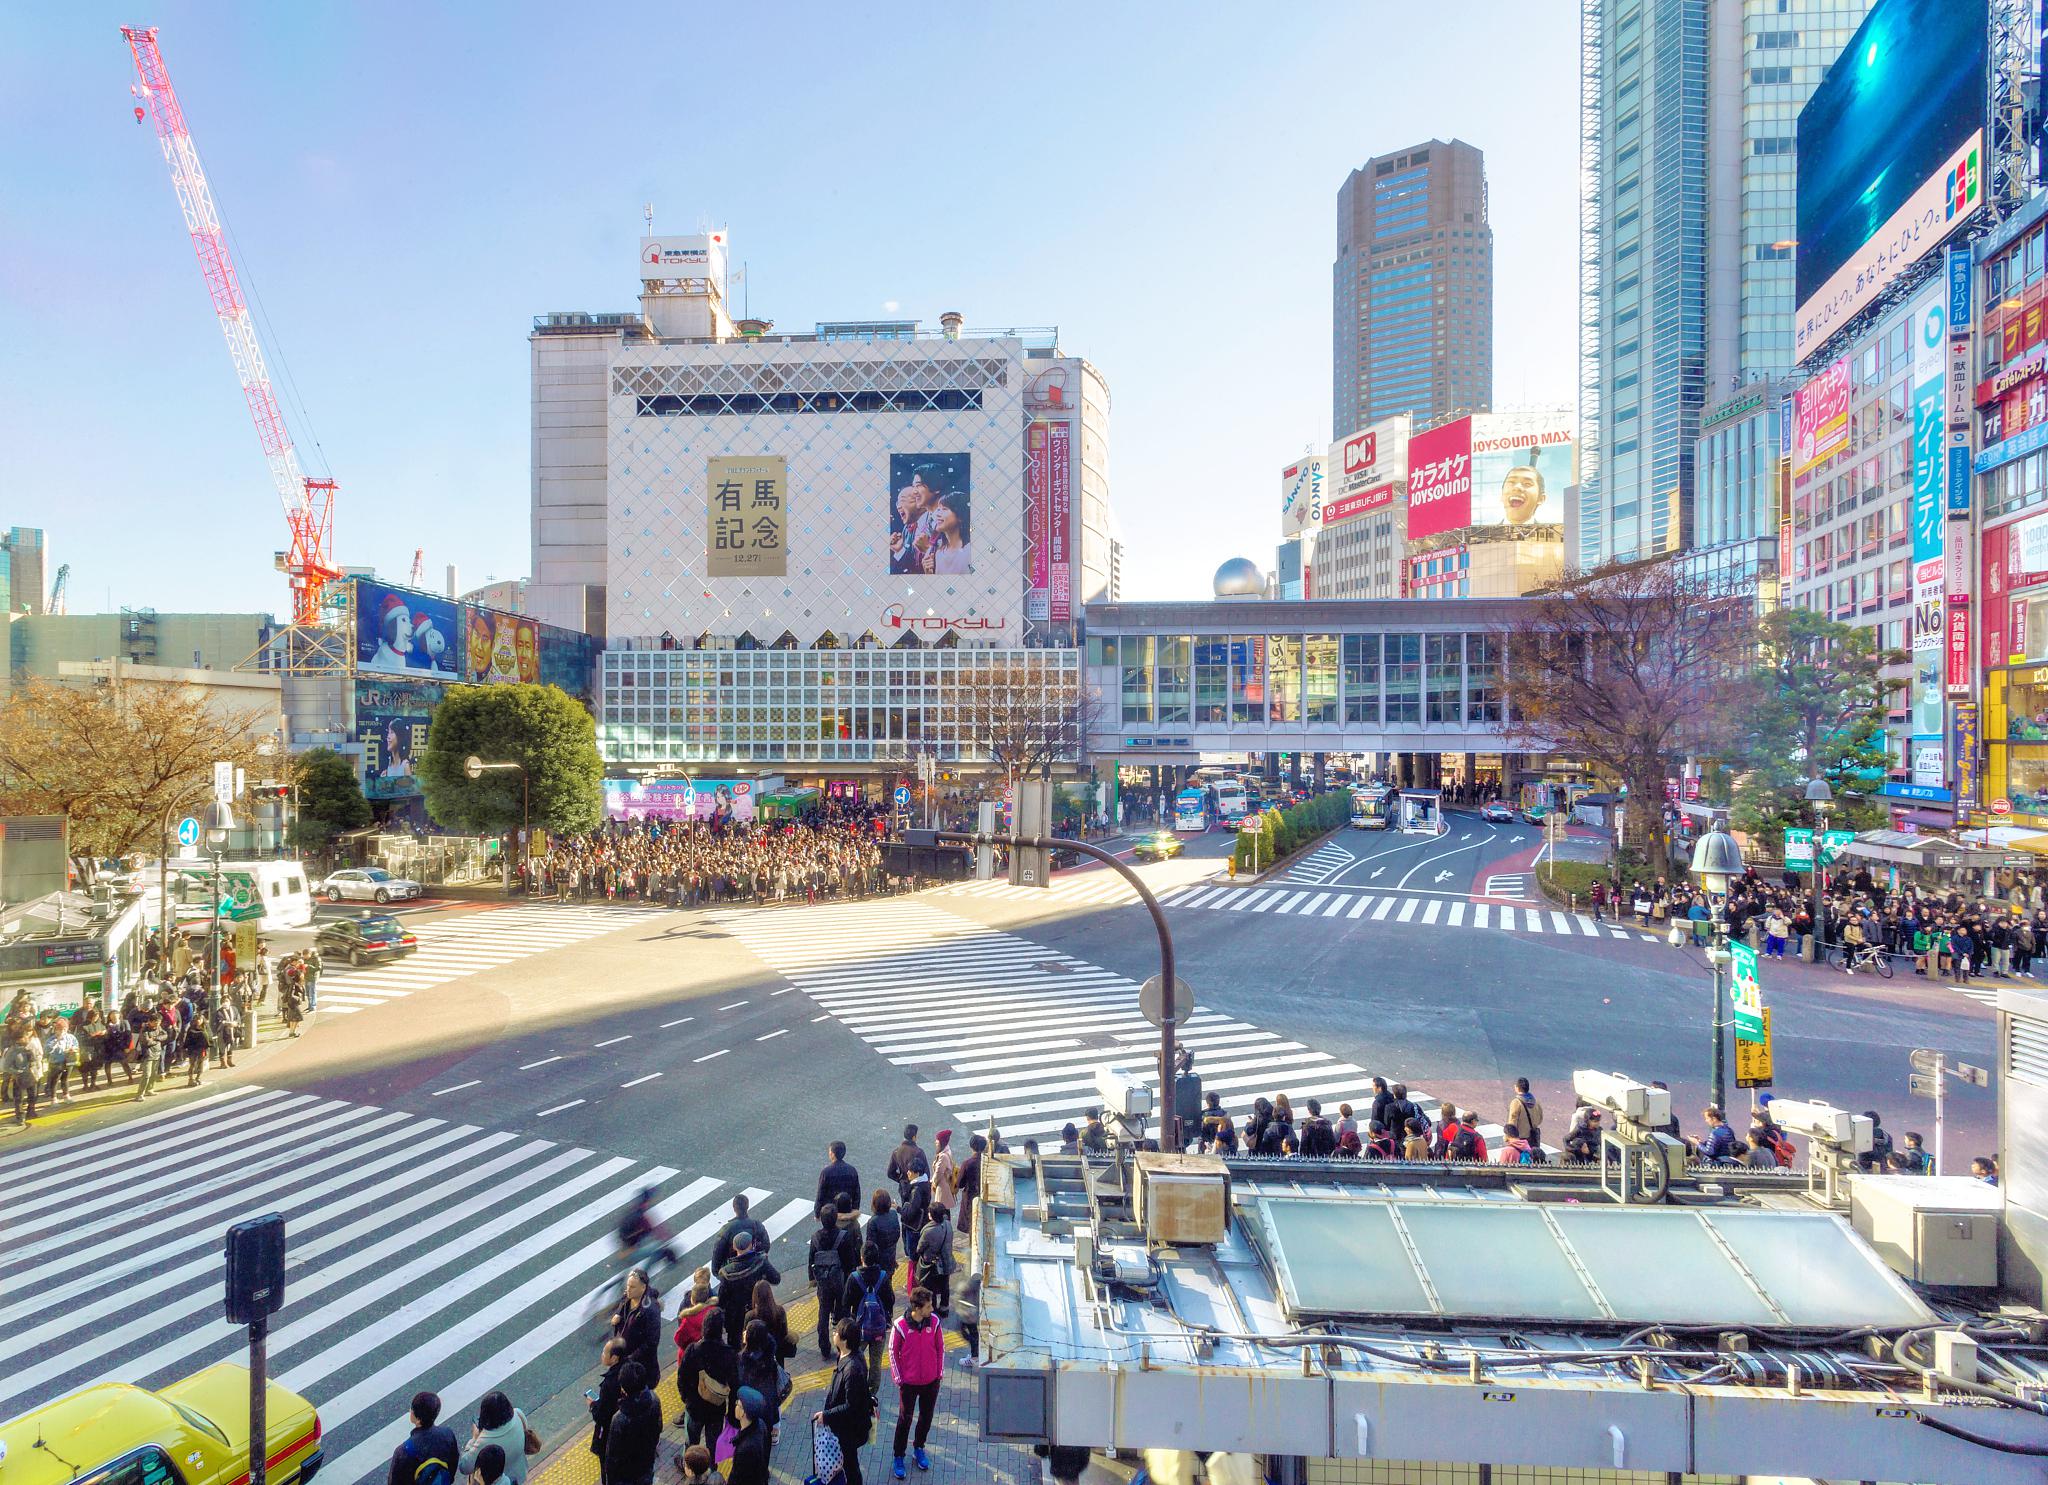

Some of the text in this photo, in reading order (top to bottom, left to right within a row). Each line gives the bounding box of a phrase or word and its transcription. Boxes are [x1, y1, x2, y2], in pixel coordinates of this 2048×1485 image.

[1797, 208, 1941, 347] 世界にひとつ。あなたにひとつ。
[1953, 263, 1967, 322] 東急リバブル
[1801, 363, 1848, 416] 品川スキン
[1953, 361, 1966, 413] 献血ルーム
[1801, 387, 1847, 438] クリニック
[1984, 414, 2001, 438] 7F
[1345, 437, 1372, 470] DC
[1473, 430, 1572, 453] JOYSOUND MAX
[1031, 450, 1041, 494] TOKYU
[1410, 453, 1469, 491] カラオケ
[1918, 394, 1935, 544] アイシティ
[715, 479, 780, 511] 有馬
[1283, 466, 1309, 515] SANKYO
[1311, 462, 1325, 520] SANKYO
[1410, 477, 1470, 507] JOYSOUND
[715, 516, 780, 549] 記念
[1031, 496, 1041, 532] CARD
[902, 617, 1004, 629] TOKYU
[360, 689, 381, 706] JR
